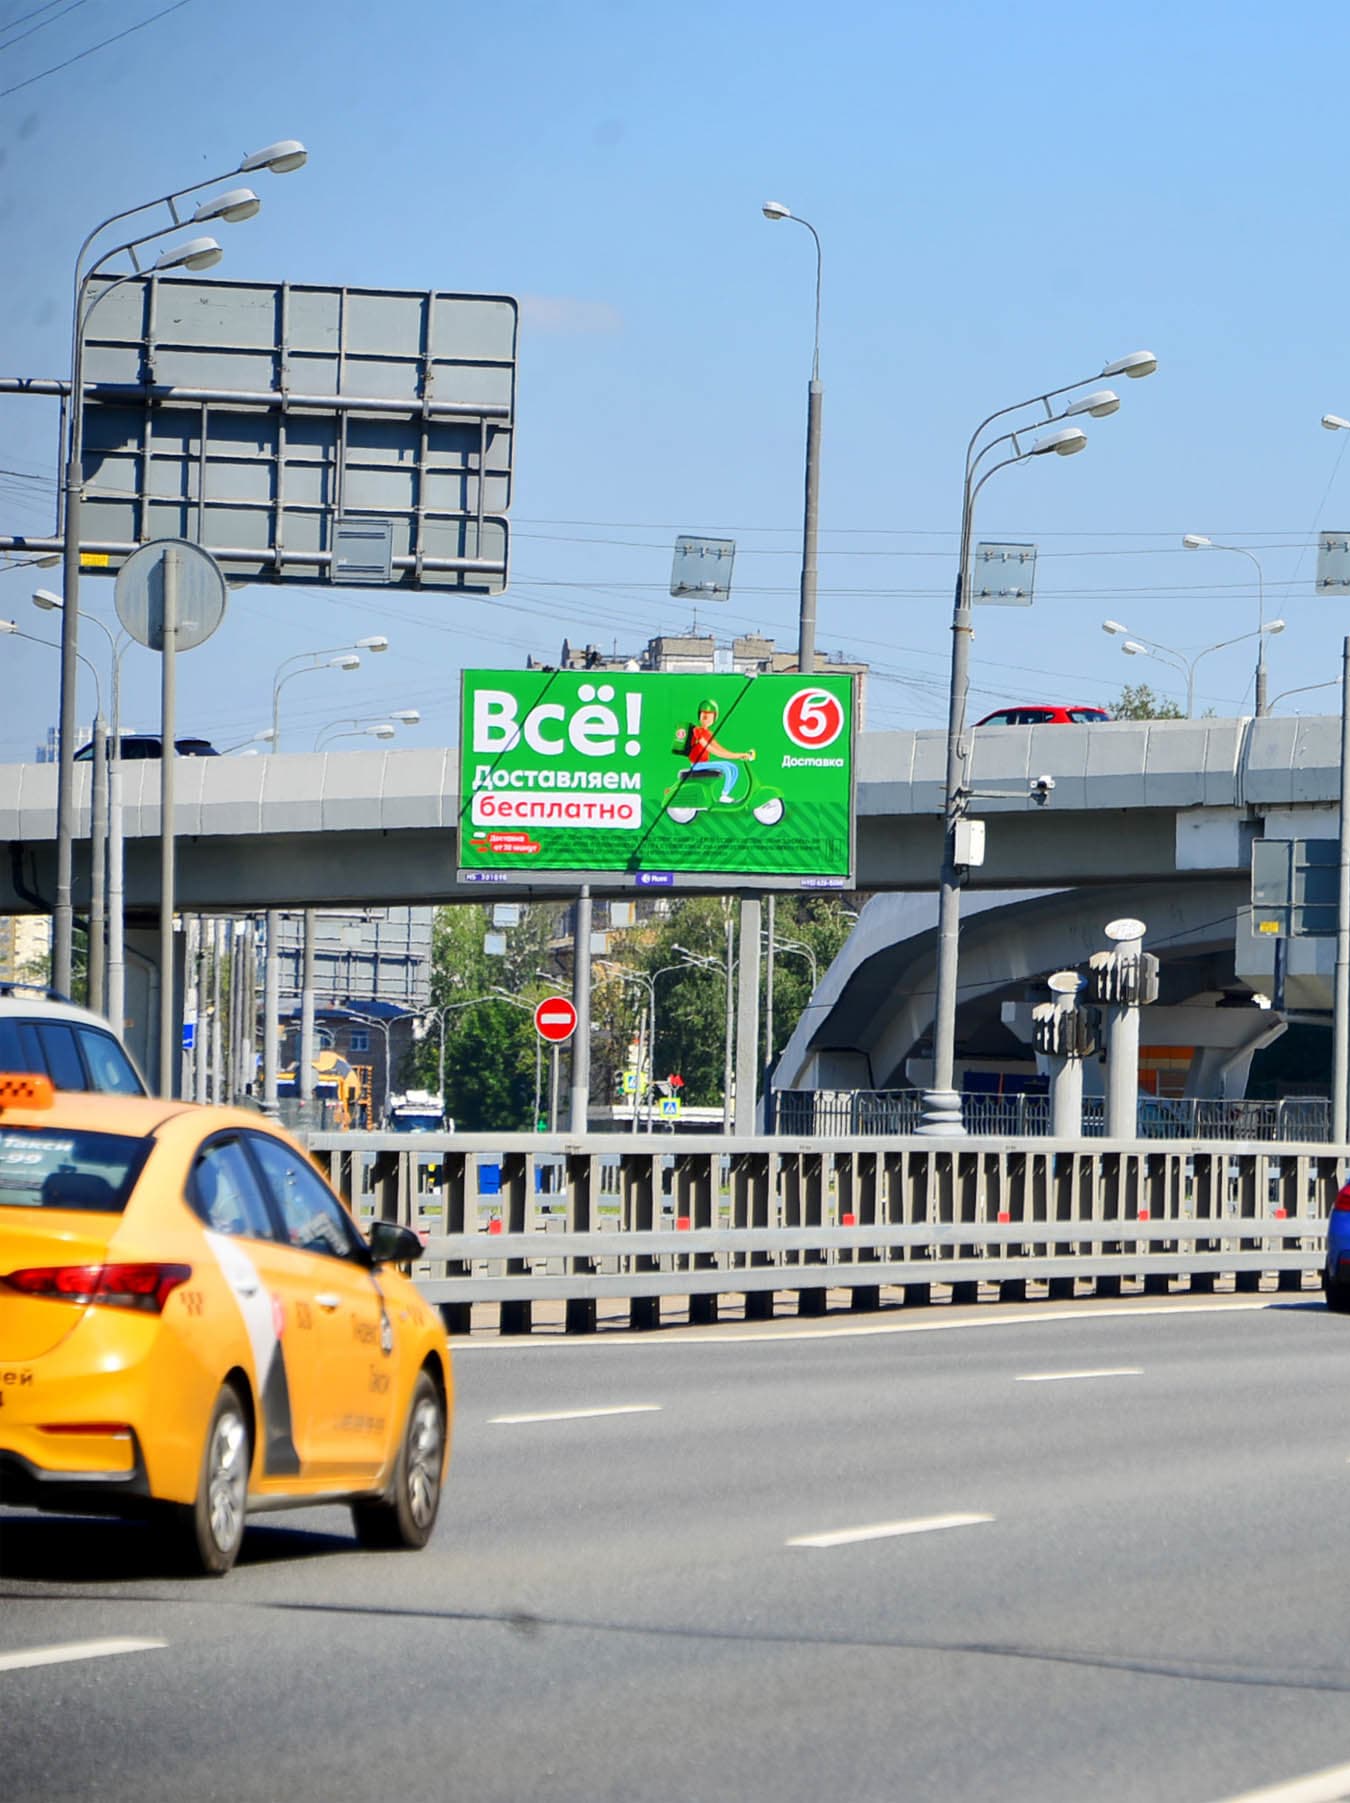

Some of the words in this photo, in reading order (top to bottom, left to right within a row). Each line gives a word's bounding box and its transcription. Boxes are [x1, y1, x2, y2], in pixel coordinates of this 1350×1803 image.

[472, 684, 643, 757] Всё!
[781, 755, 844, 769] Доставка
[471, 765, 641, 793] Доставляем
[479, 795, 634, 820] бесплатно
[3, 1136, 74, 1152] Такси
